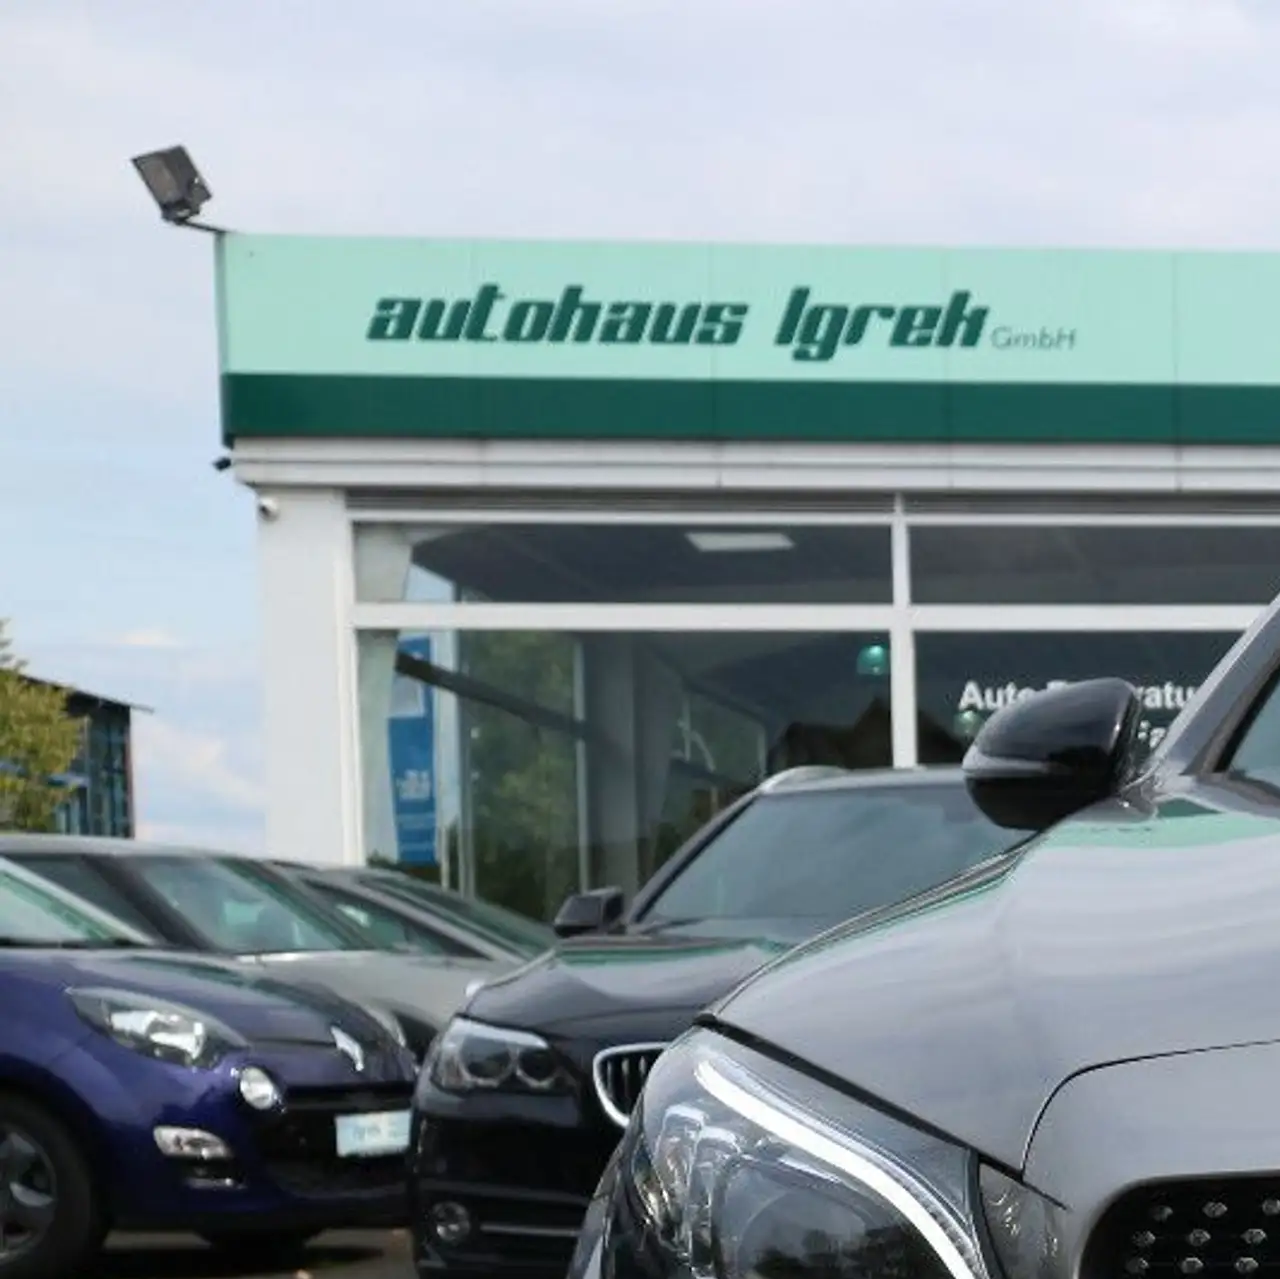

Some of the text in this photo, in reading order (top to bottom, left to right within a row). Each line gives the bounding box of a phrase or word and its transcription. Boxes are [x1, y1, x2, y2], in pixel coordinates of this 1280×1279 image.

[366, 284, 1078, 362] autohaus Igrek GmbH
